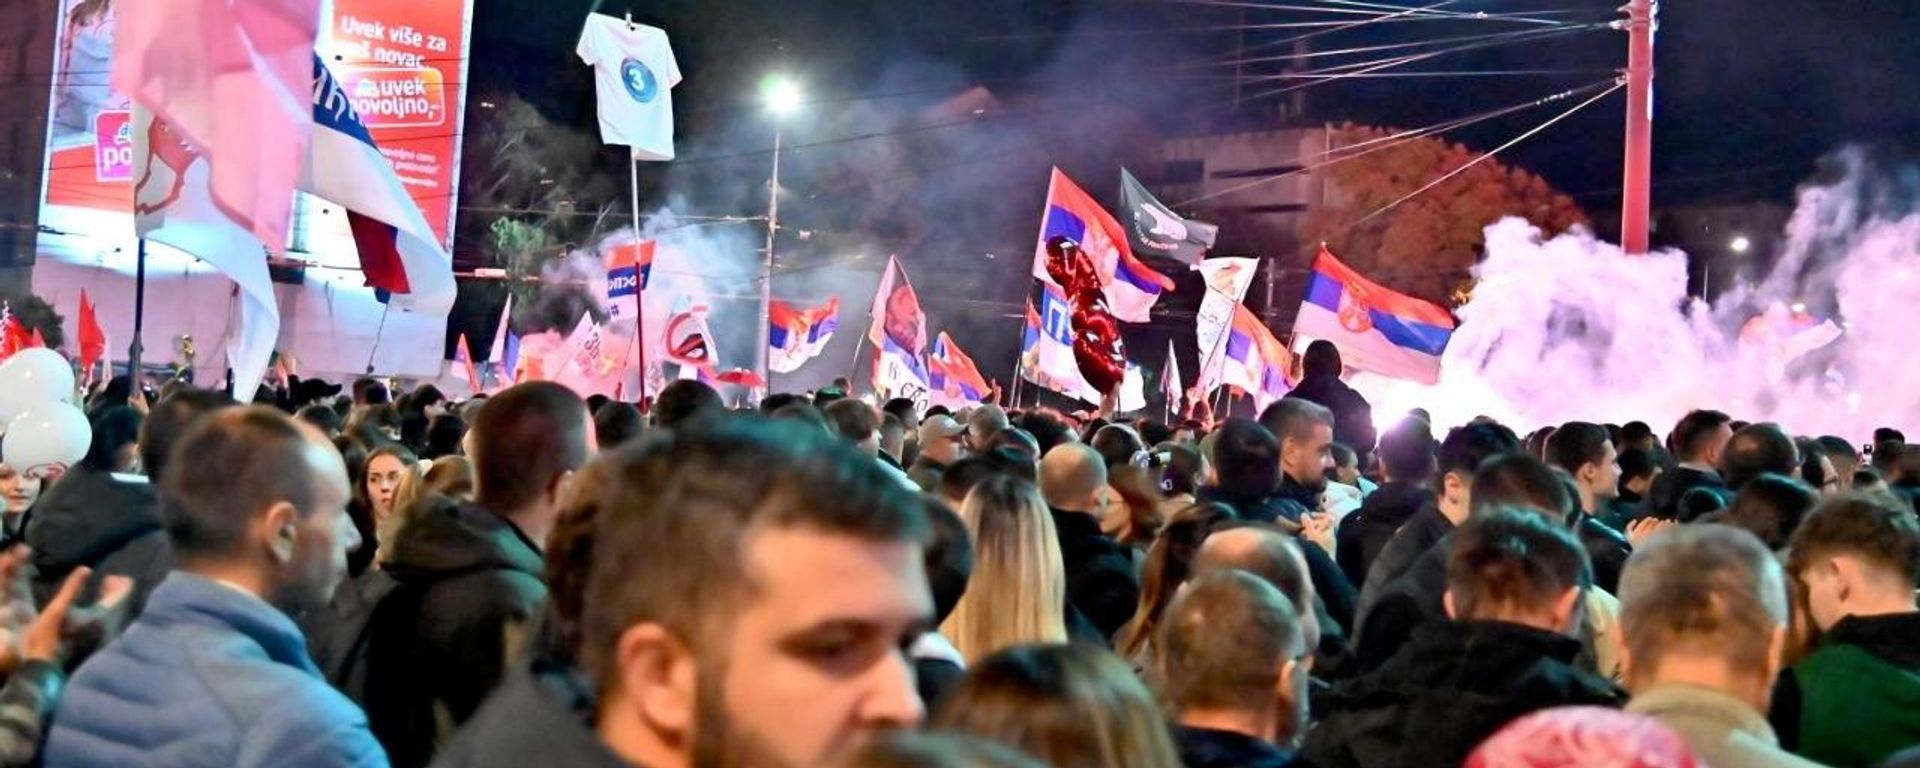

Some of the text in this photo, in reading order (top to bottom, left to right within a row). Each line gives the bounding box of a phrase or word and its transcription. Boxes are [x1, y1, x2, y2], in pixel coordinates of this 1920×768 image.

[341, 16, 447, 51] Uvek više za
[380, 77, 426, 95] uvek
[629, 68, 645, 91] 3
